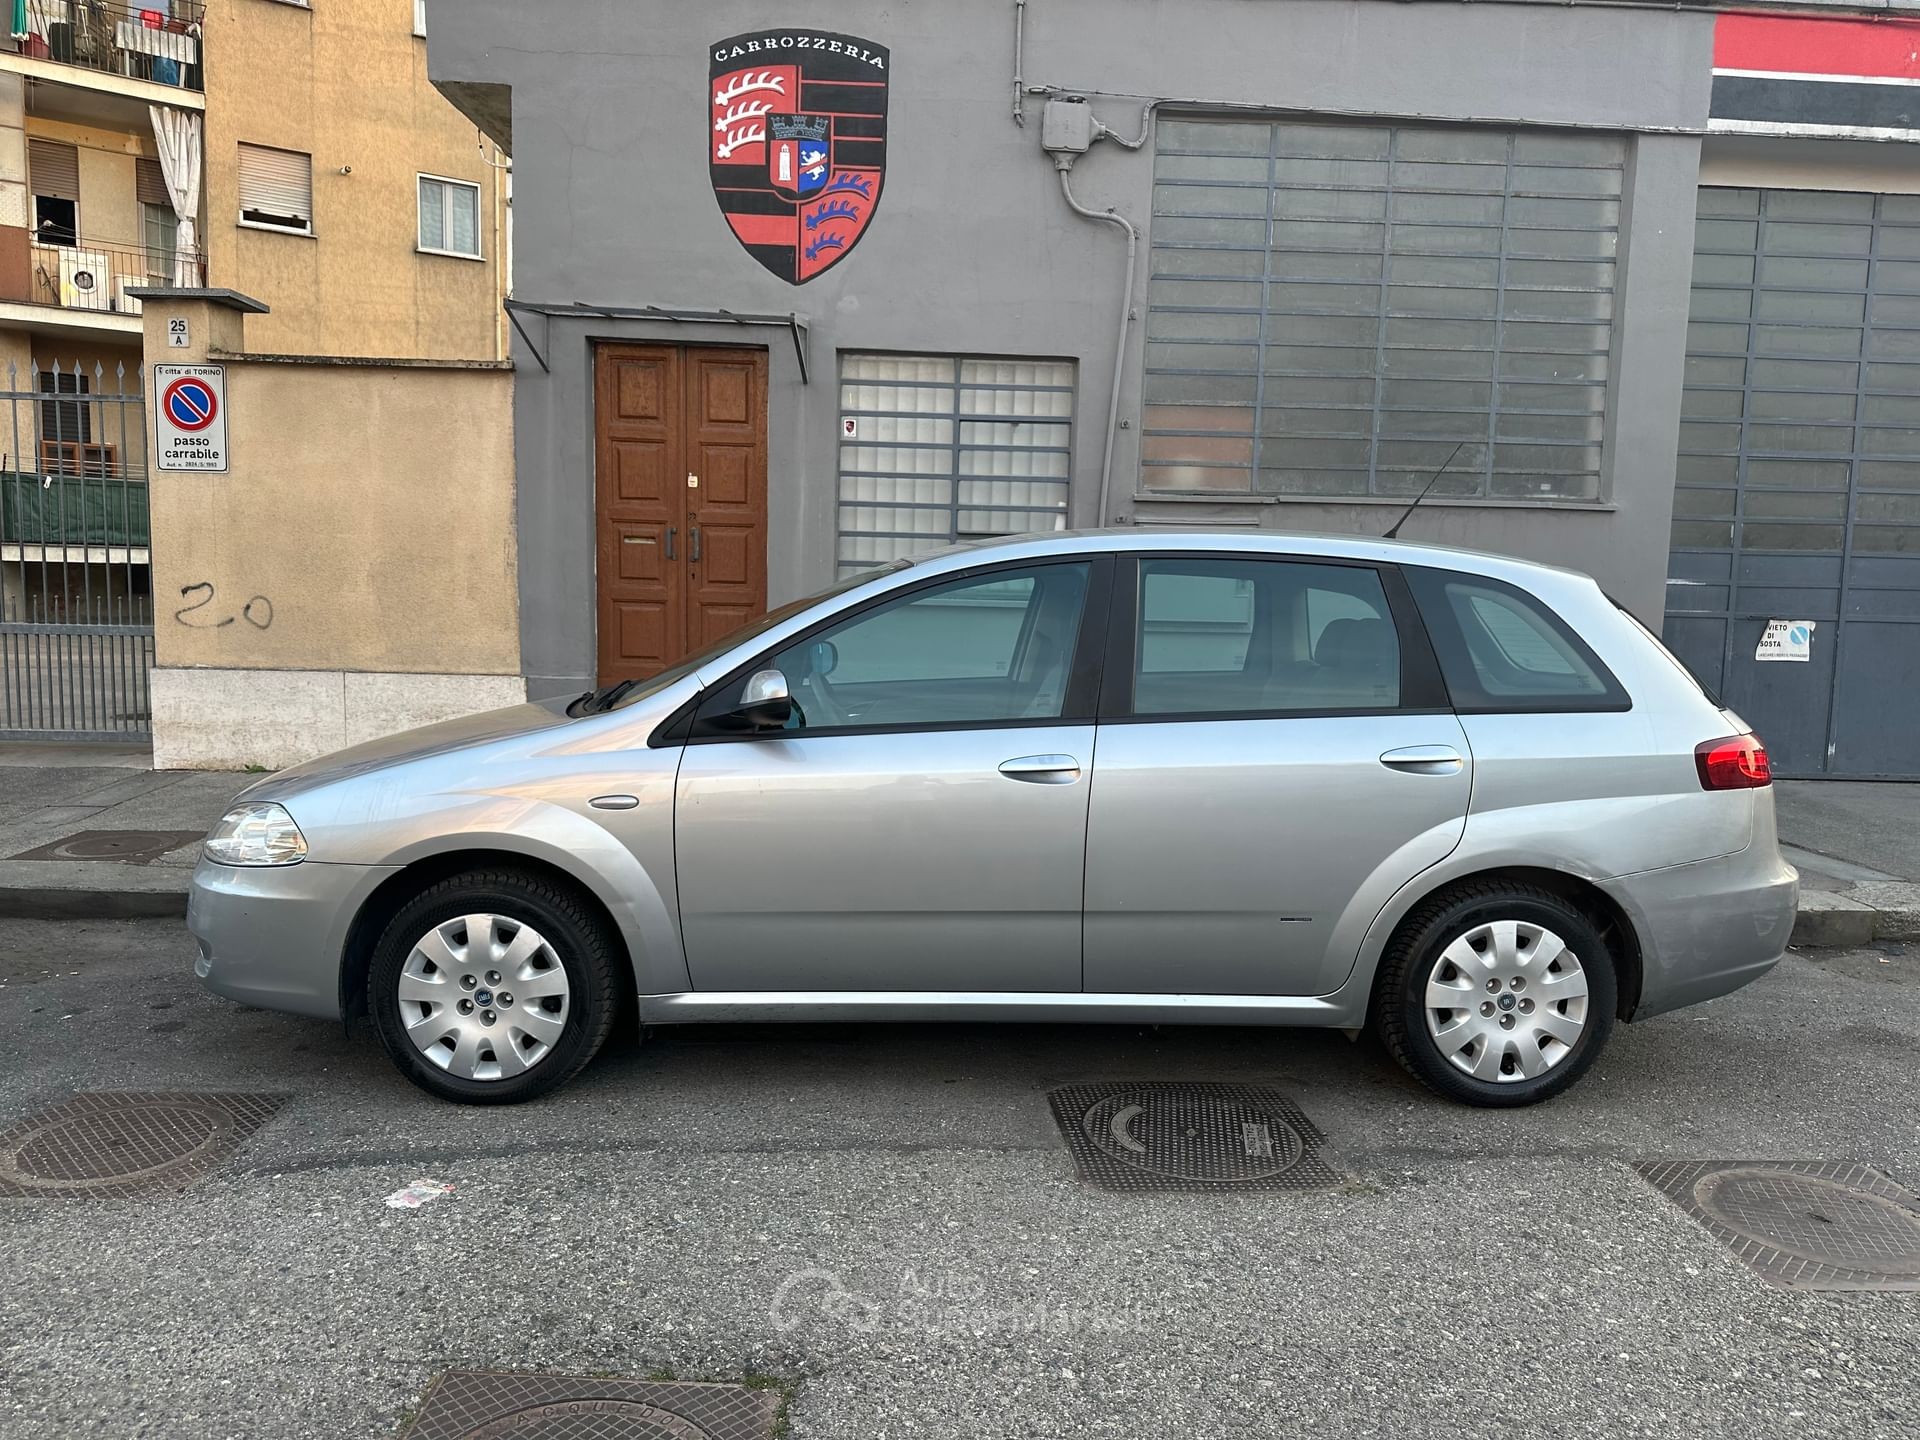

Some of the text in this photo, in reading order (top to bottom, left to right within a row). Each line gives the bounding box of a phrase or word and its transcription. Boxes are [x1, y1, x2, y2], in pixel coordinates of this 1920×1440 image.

[715, 36, 885, 69] CARROZZERIA
[170, 320, 186, 332] 25
[175, 335, 182, 344] A
[193, 368, 221, 376] TORINO
[174, 437, 210, 448] passo
[165, 448, 219, 459] carrabile
[516, 1401, 707, 1440] ACQUEDOT
